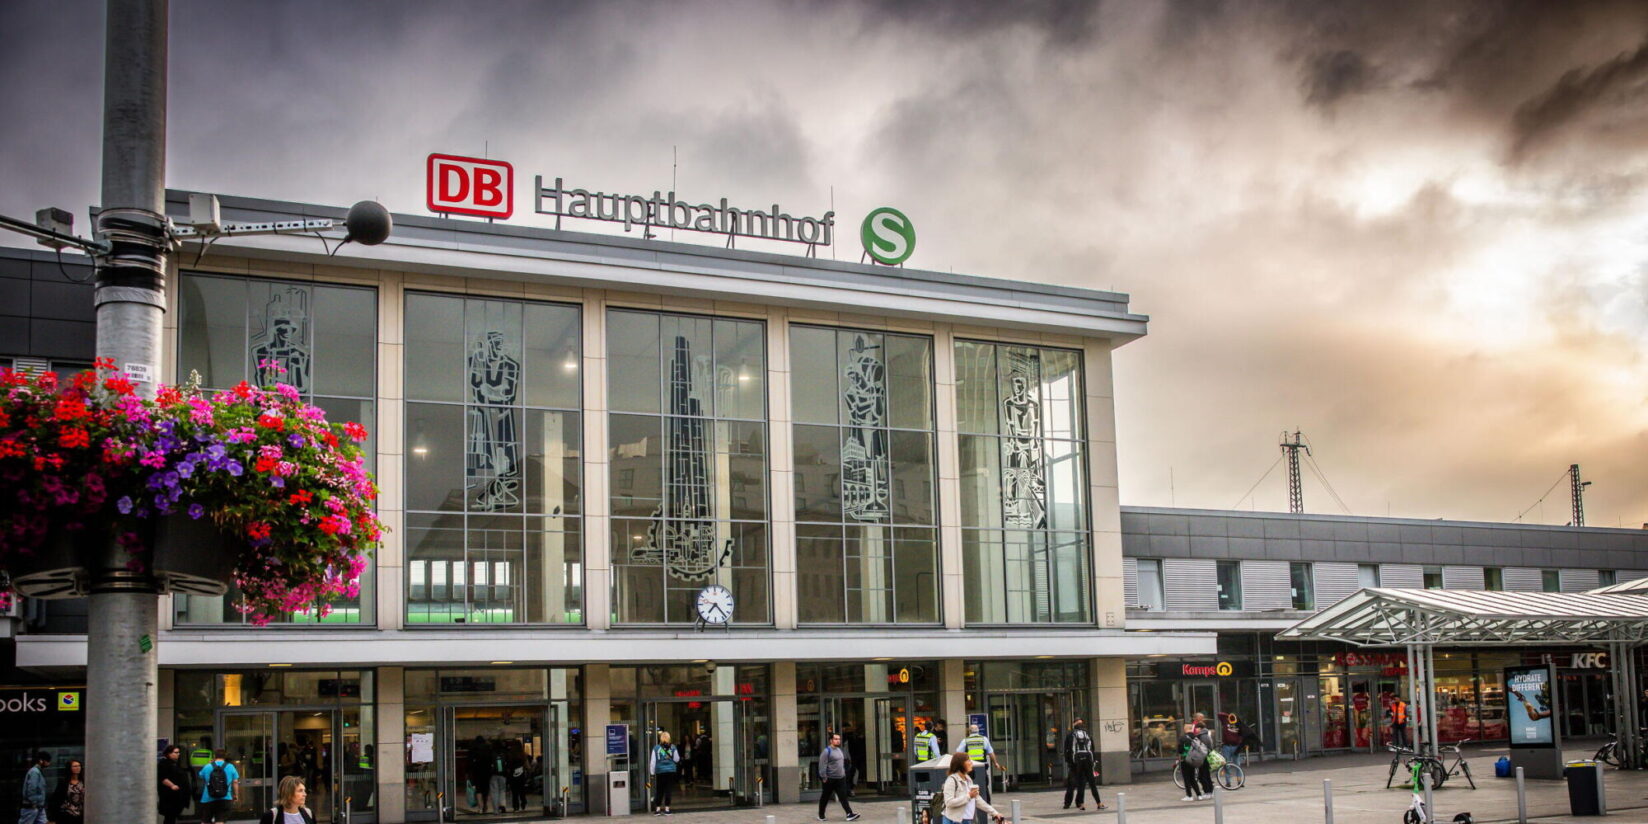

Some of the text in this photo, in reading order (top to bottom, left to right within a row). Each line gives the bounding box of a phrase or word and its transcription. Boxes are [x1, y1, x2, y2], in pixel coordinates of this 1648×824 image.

[438, 163, 503, 207] DB
[534, 175, 835, 246] Hauptbahnhof
[870, 211, 908, 260] S
[1182, 664, 1216, 677] Kamps
[1571, 653, 1607, 669] KFC
[1514, 673, 1541, 683] HYDRATE
